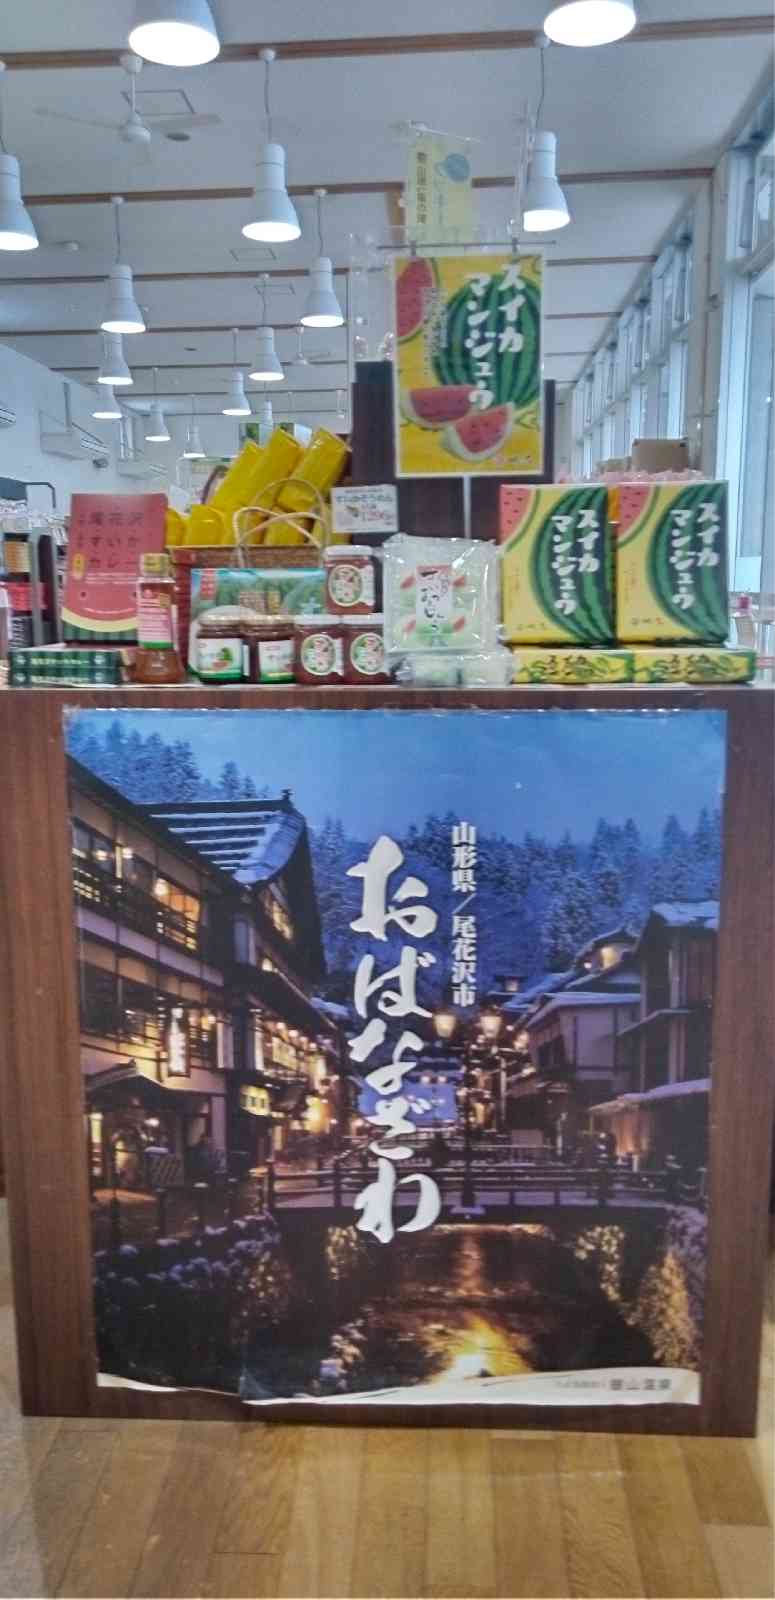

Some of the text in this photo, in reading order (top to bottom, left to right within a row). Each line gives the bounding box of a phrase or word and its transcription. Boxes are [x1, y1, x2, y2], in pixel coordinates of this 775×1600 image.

[464, 272, 497, 410] マンジュウ
[498, 263, 527, 354] スイカ
[551, 514, 577, 615] マンジュウ
[577, 509, 600, 573] スイカ
[668, 509, 696, 610] マンジュウ
[697, 502, 720, 567] スイカ
[451, 821, 477, 1007] 山形県／尾花沢市
[346, 834, 442, 1245] おばなざわ
